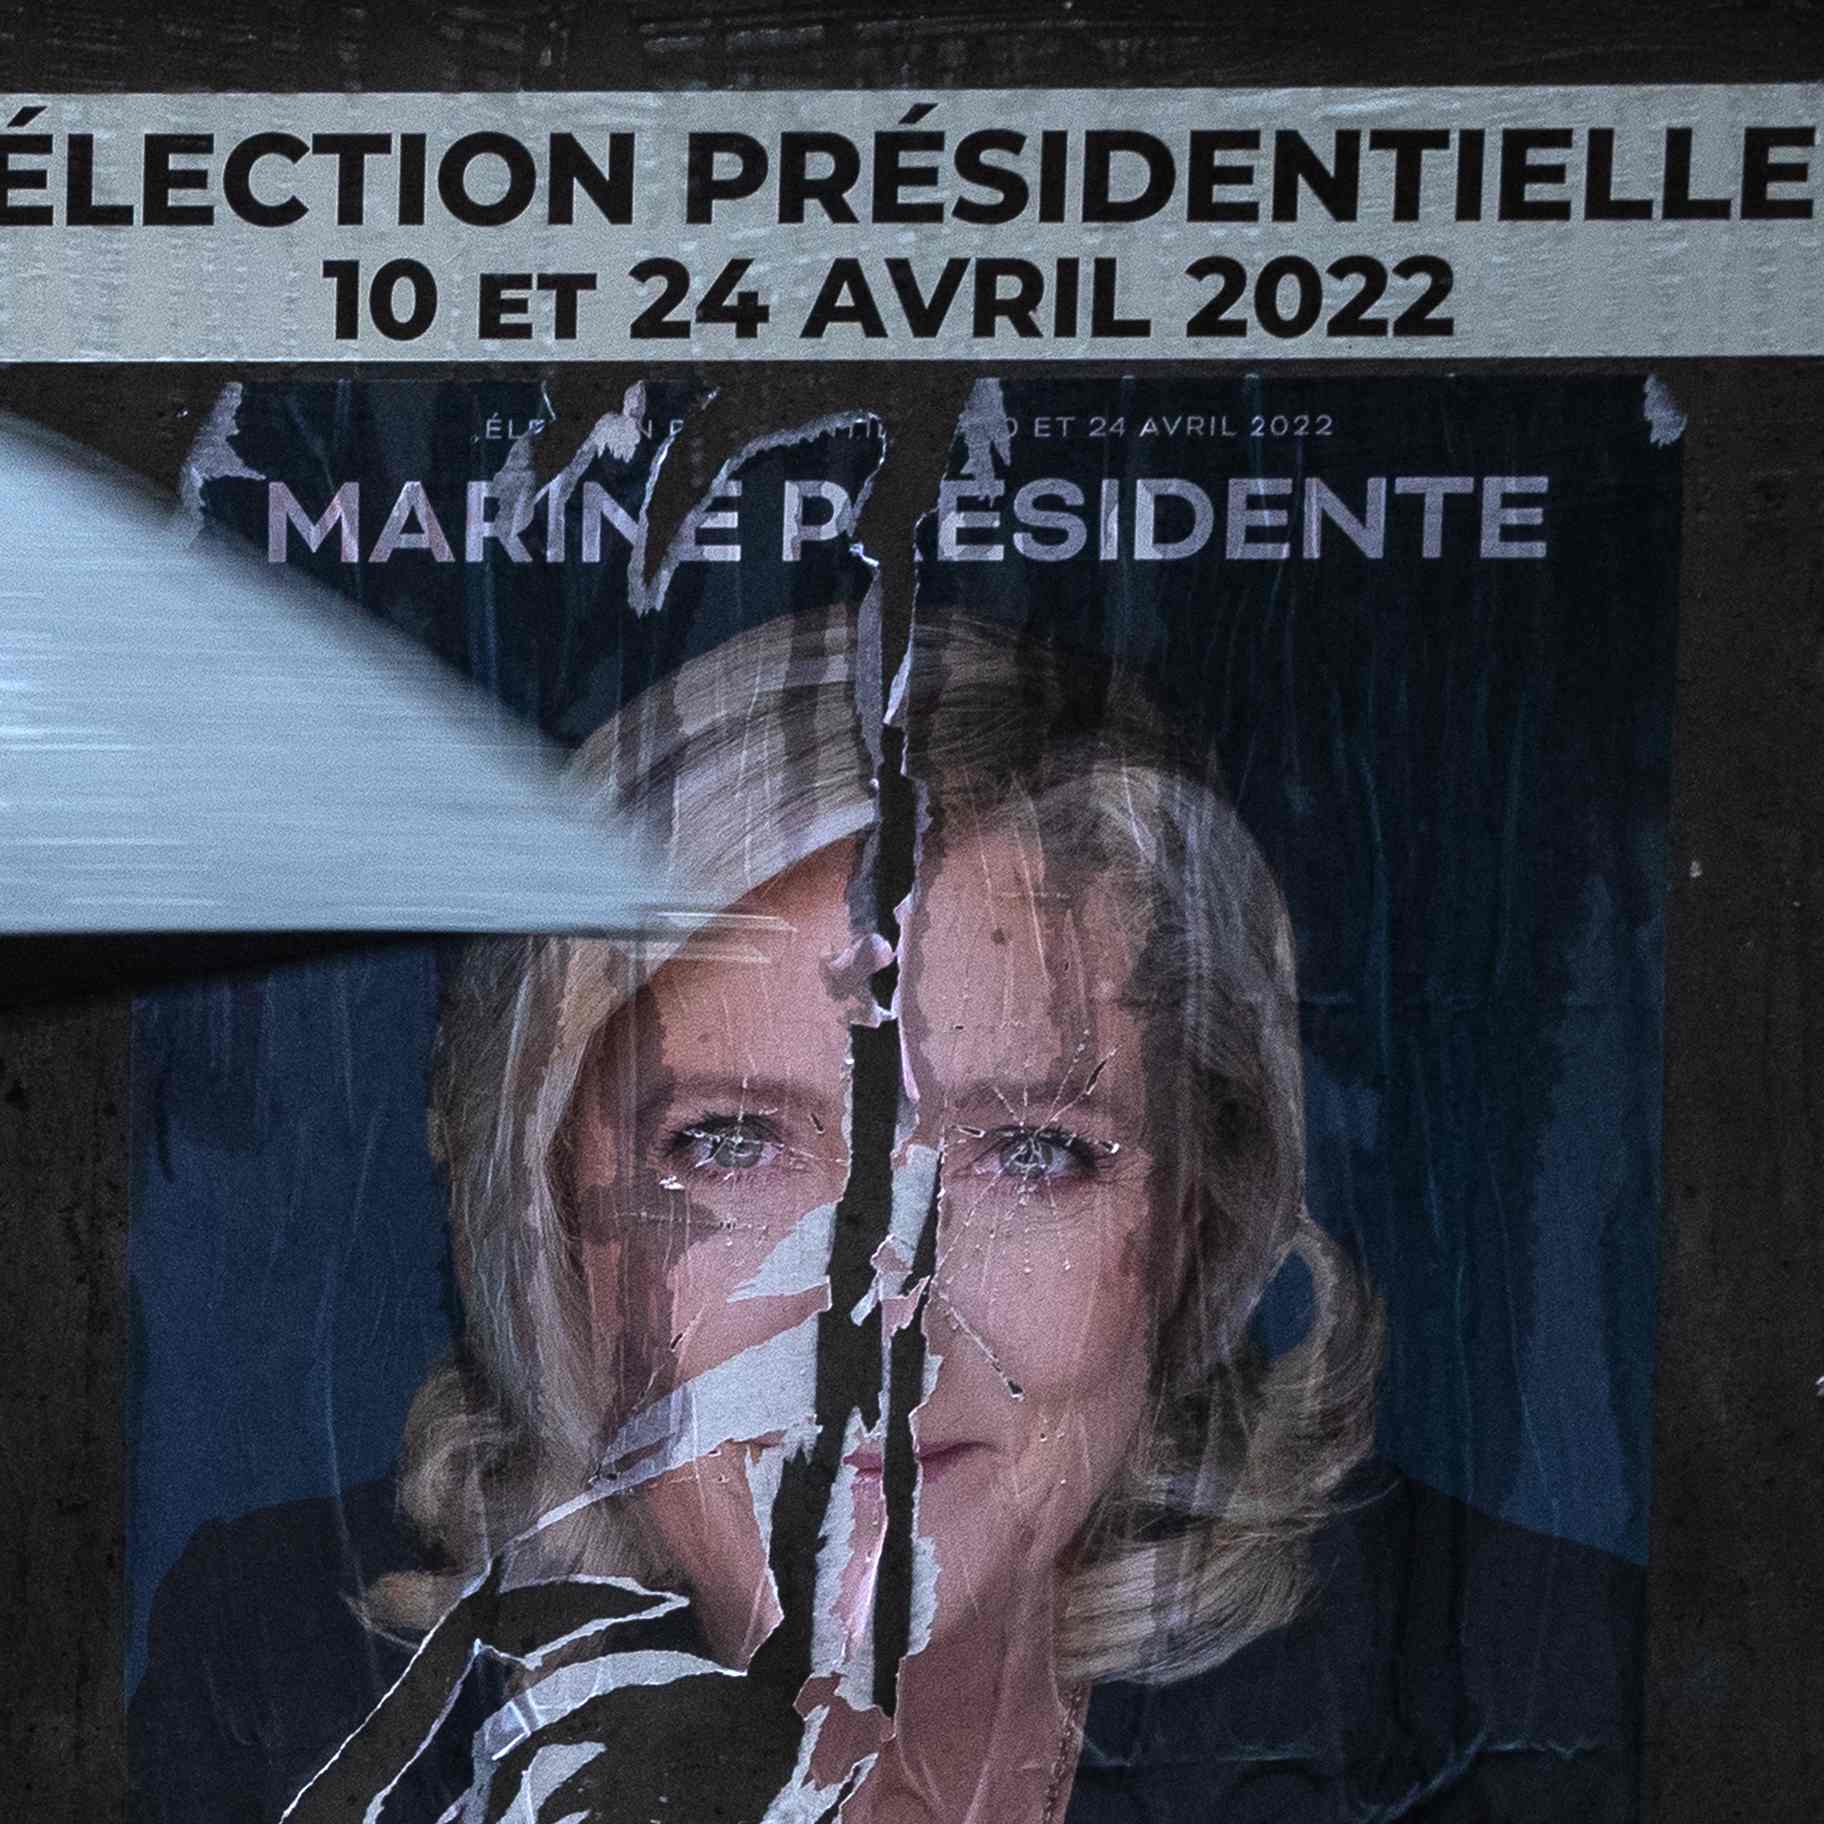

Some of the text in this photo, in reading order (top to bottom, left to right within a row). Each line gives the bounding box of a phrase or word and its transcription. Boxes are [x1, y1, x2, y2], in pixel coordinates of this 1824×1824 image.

[684, 102, 1817, 226] PRÉSIDENTIELLE
[322, 255, 1456, 341] 10 ET 24 AVRIL 2022
[1033, 416, 1077, 438] ET
[1088, 416, 1126, 437] 24
[1139, 416, 1237, 437] AVRIL
[1249, 414, 1334, 437] 2022
[266, 479, 743, 564] MARINE
